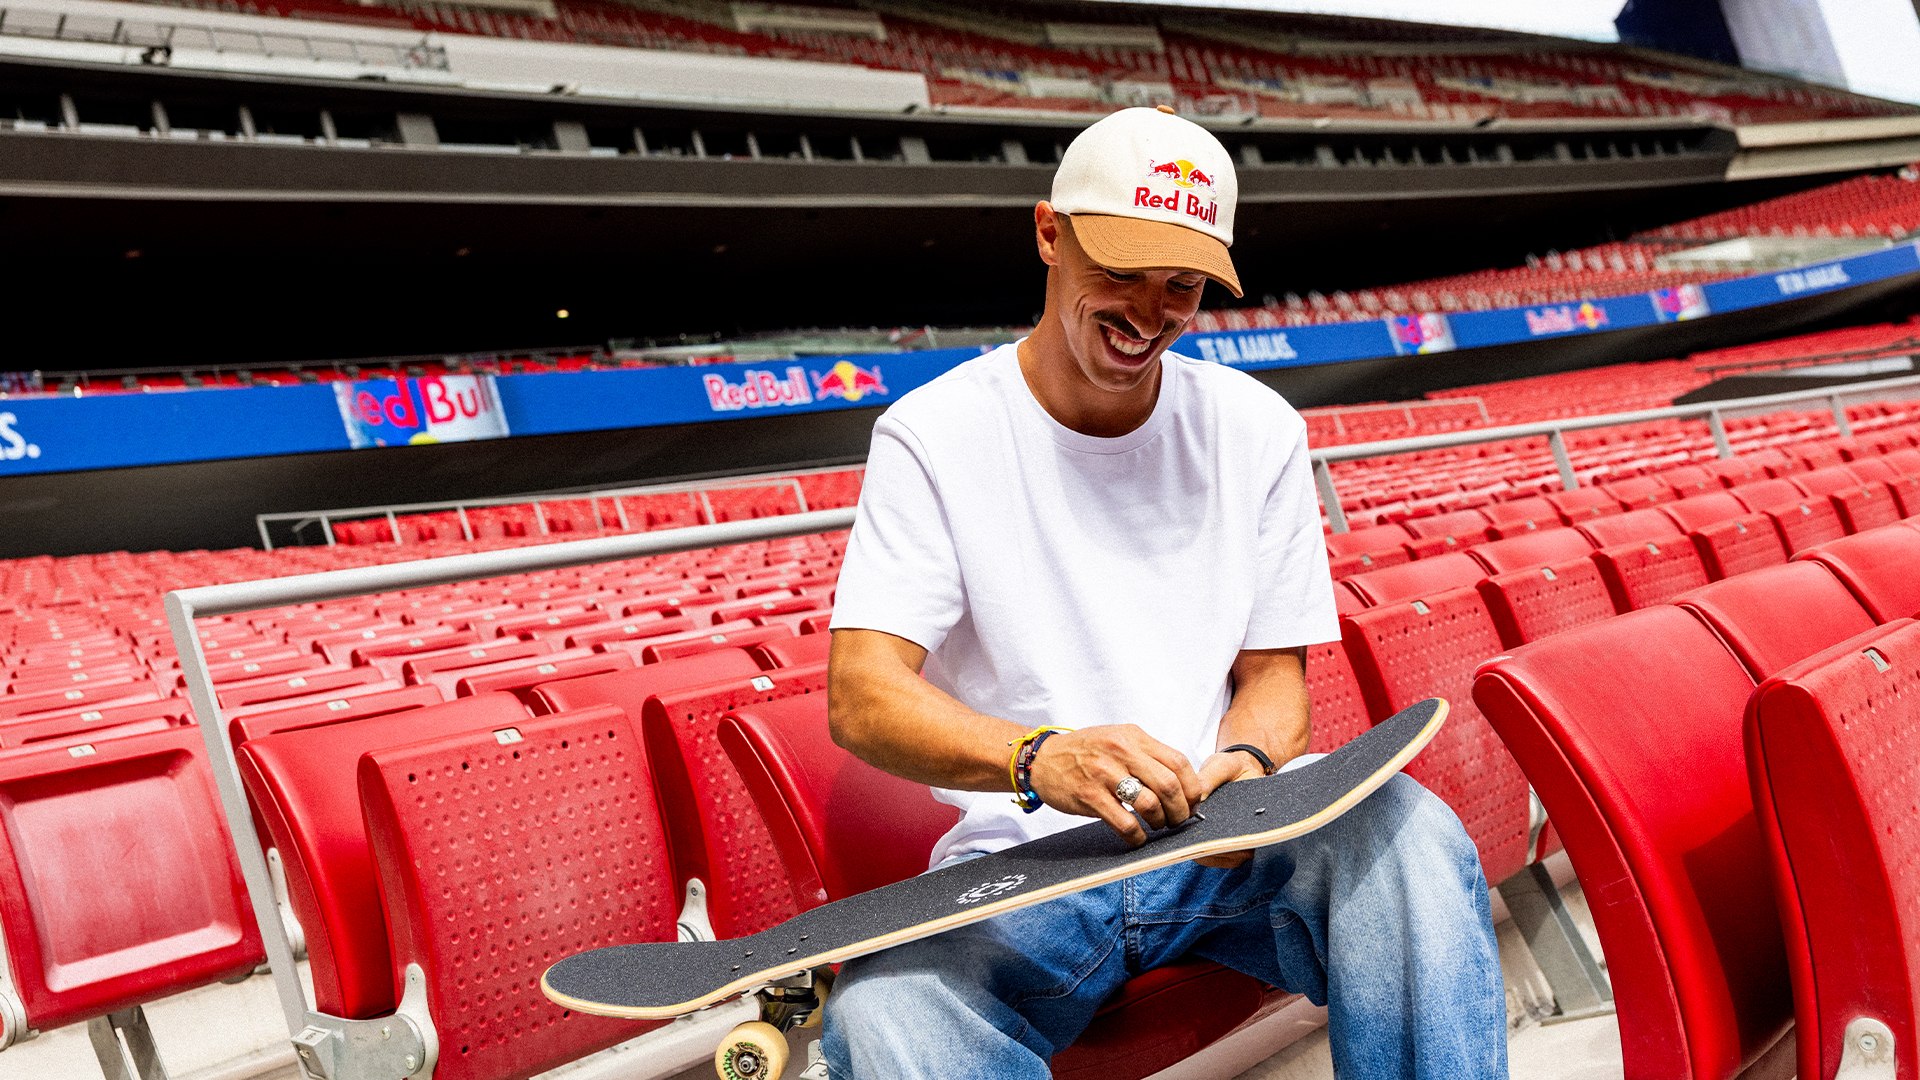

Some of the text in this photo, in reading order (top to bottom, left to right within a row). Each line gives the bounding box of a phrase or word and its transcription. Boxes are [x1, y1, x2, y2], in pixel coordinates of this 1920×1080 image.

[1134, 187, 1218, 226] Red Bull
[703, 366, 814, 411] Red Bull
[757, 678, 767, 689] 2
